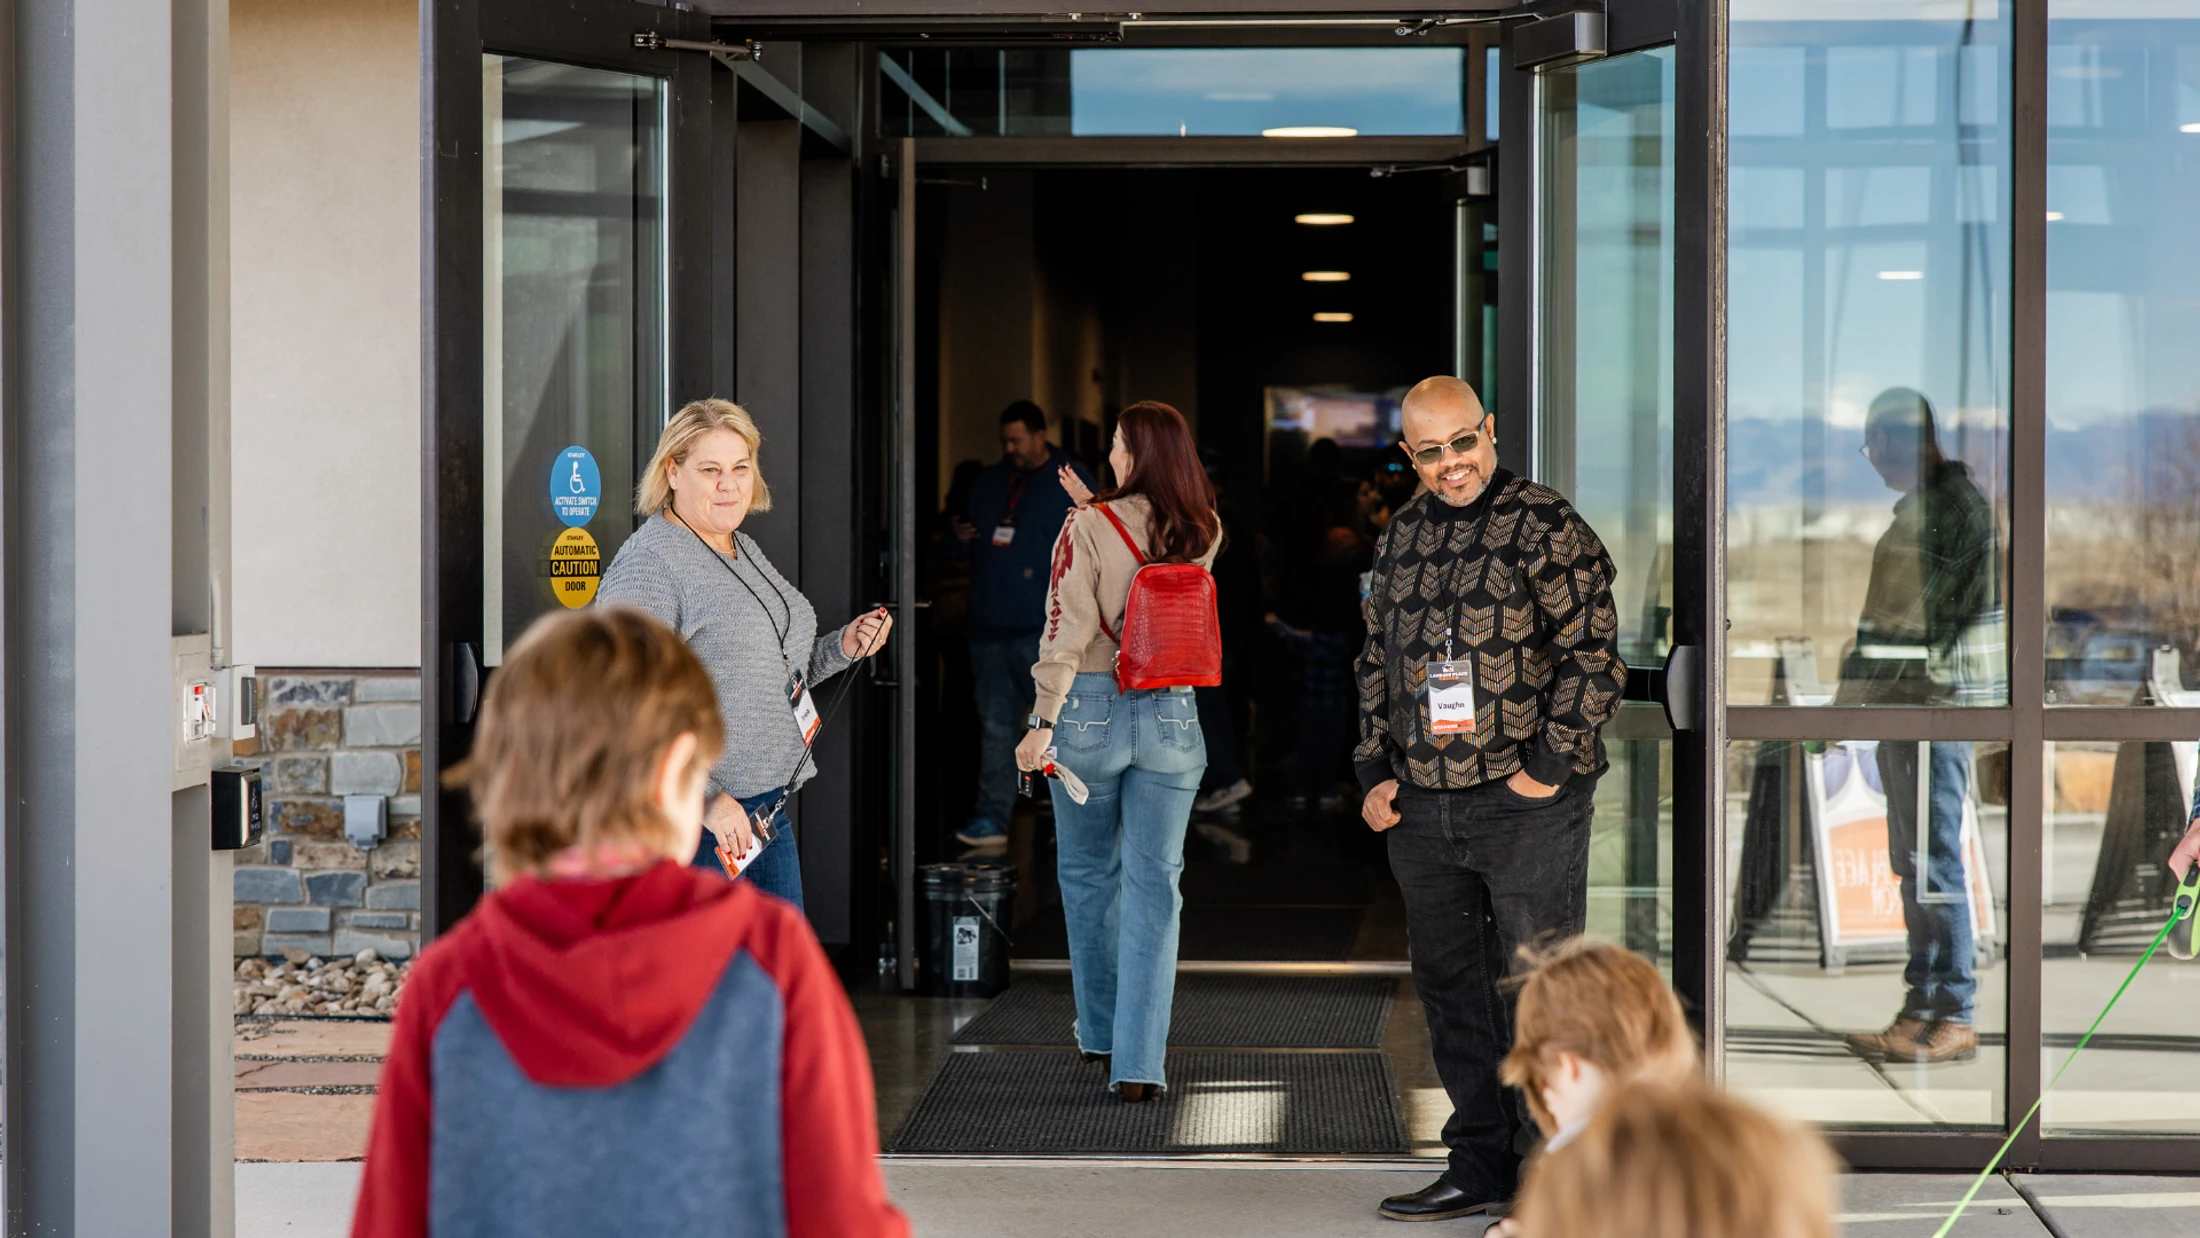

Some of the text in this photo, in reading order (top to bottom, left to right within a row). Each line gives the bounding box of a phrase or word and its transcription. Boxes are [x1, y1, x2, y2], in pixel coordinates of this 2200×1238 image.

[555, 496, 597, 505] ACTIVATE SWITCH
[562, 507, 590, 516] TO OPERATE
[554, 545, 597, 556] AUTOMATIC
[552, 561, 598, 576] CAUTION
[565, 581, 586, 592] DOOR
[1438, 701, 1465, 710] Vaughn
